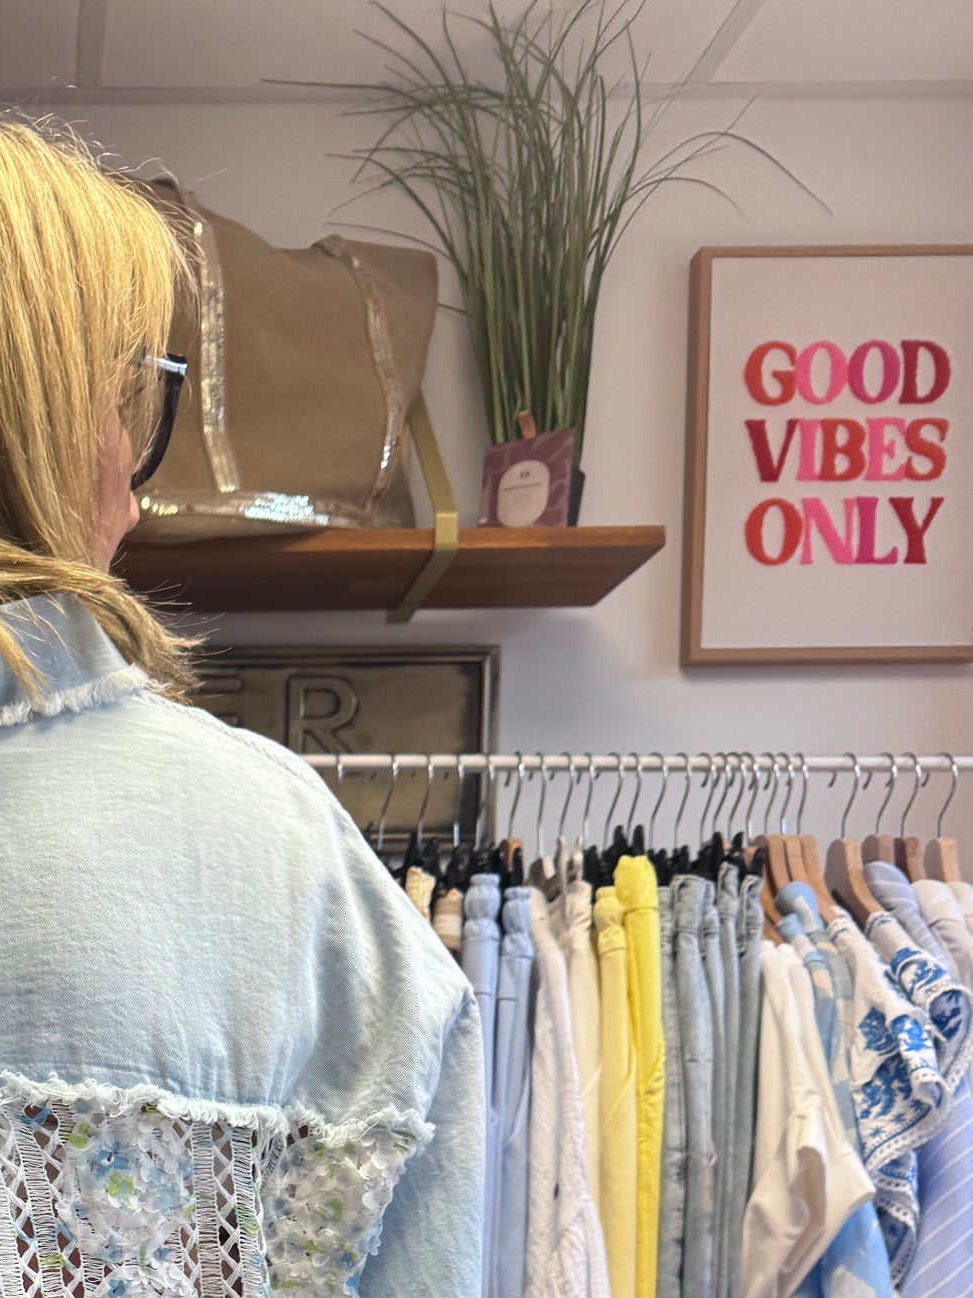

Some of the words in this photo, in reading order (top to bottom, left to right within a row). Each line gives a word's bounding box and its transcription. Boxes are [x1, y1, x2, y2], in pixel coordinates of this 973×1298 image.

[744, 340, 951, 405] GOOD
[744, 417, 949, 482] VIBES
[744, 496, 944, 565] ONLY
